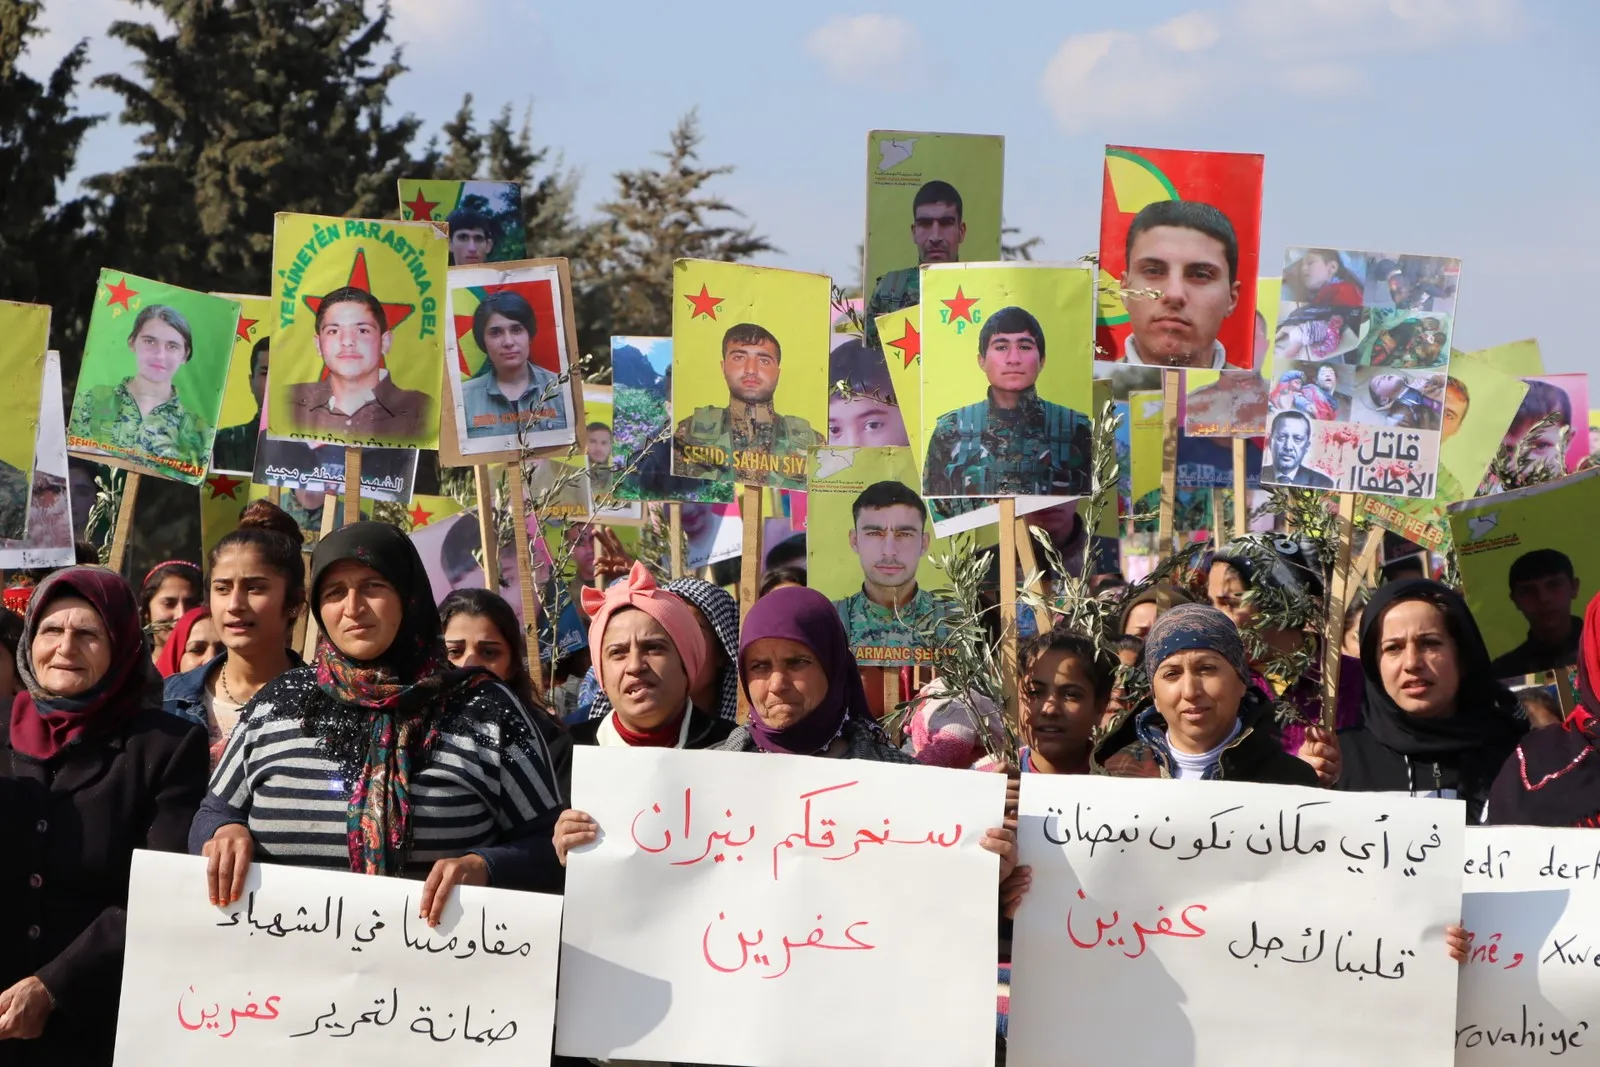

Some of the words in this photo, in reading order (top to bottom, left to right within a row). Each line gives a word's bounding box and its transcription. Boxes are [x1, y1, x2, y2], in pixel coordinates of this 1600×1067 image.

[420, 297, 437, 340] GEL
[1357, 431, 1420, 465] قاتل
[300, 464, 345, 485] صطفى
[1336, 461, 1434, 497] الأطفال
[1363, 498, 1405, 529] ESMER
[1404, 517, 1445, 545] HELEB
[856, 646, 911, 660] ARMANC
[631, 787, 756, 867] بنيران
[1042, 801, 1141, 859] نبضات
[1149, 805, 1245, 861] نكون
[1245, 801, 1332, 855] مكان
[1339, 813, 1391, 874] أي
[1405, 822, 1442, 877] في
[216, 892, 345, 940] الشهباء
[353, 909, 386, 953] في
[1066, 888, 1208, 960] عفرين
[702, 910, 876, 980] عفرين
[1228, 919, 1326, 969] لأجل
[1334, 929, 1416, 981] قلبنا
[176, 983, 282, 1038] عفرين
[288, 986, 399, 1038] لتحرير
[409, 1003, 518, 1047] ضمانة
